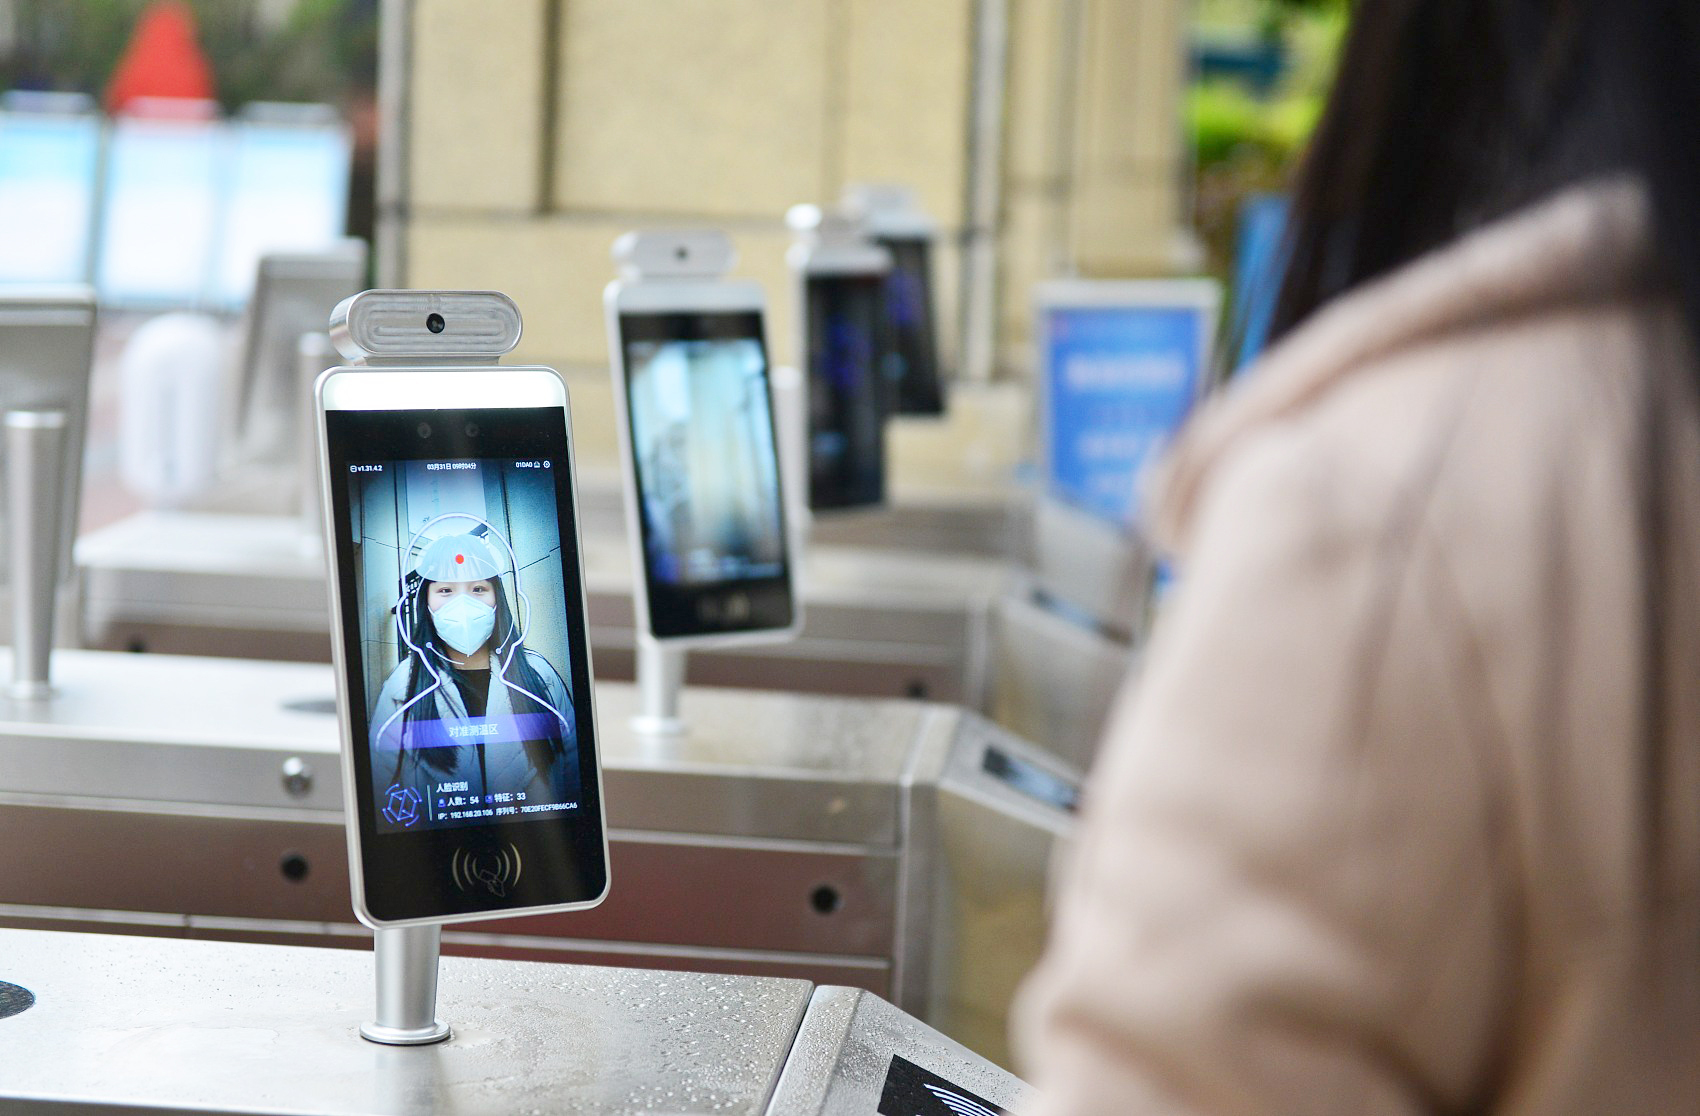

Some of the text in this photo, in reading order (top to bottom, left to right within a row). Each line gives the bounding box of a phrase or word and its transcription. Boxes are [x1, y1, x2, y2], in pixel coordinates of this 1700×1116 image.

[449, 723, 499, 737] 对准测温区
[436, 781, 468, 793] 人脸识别
